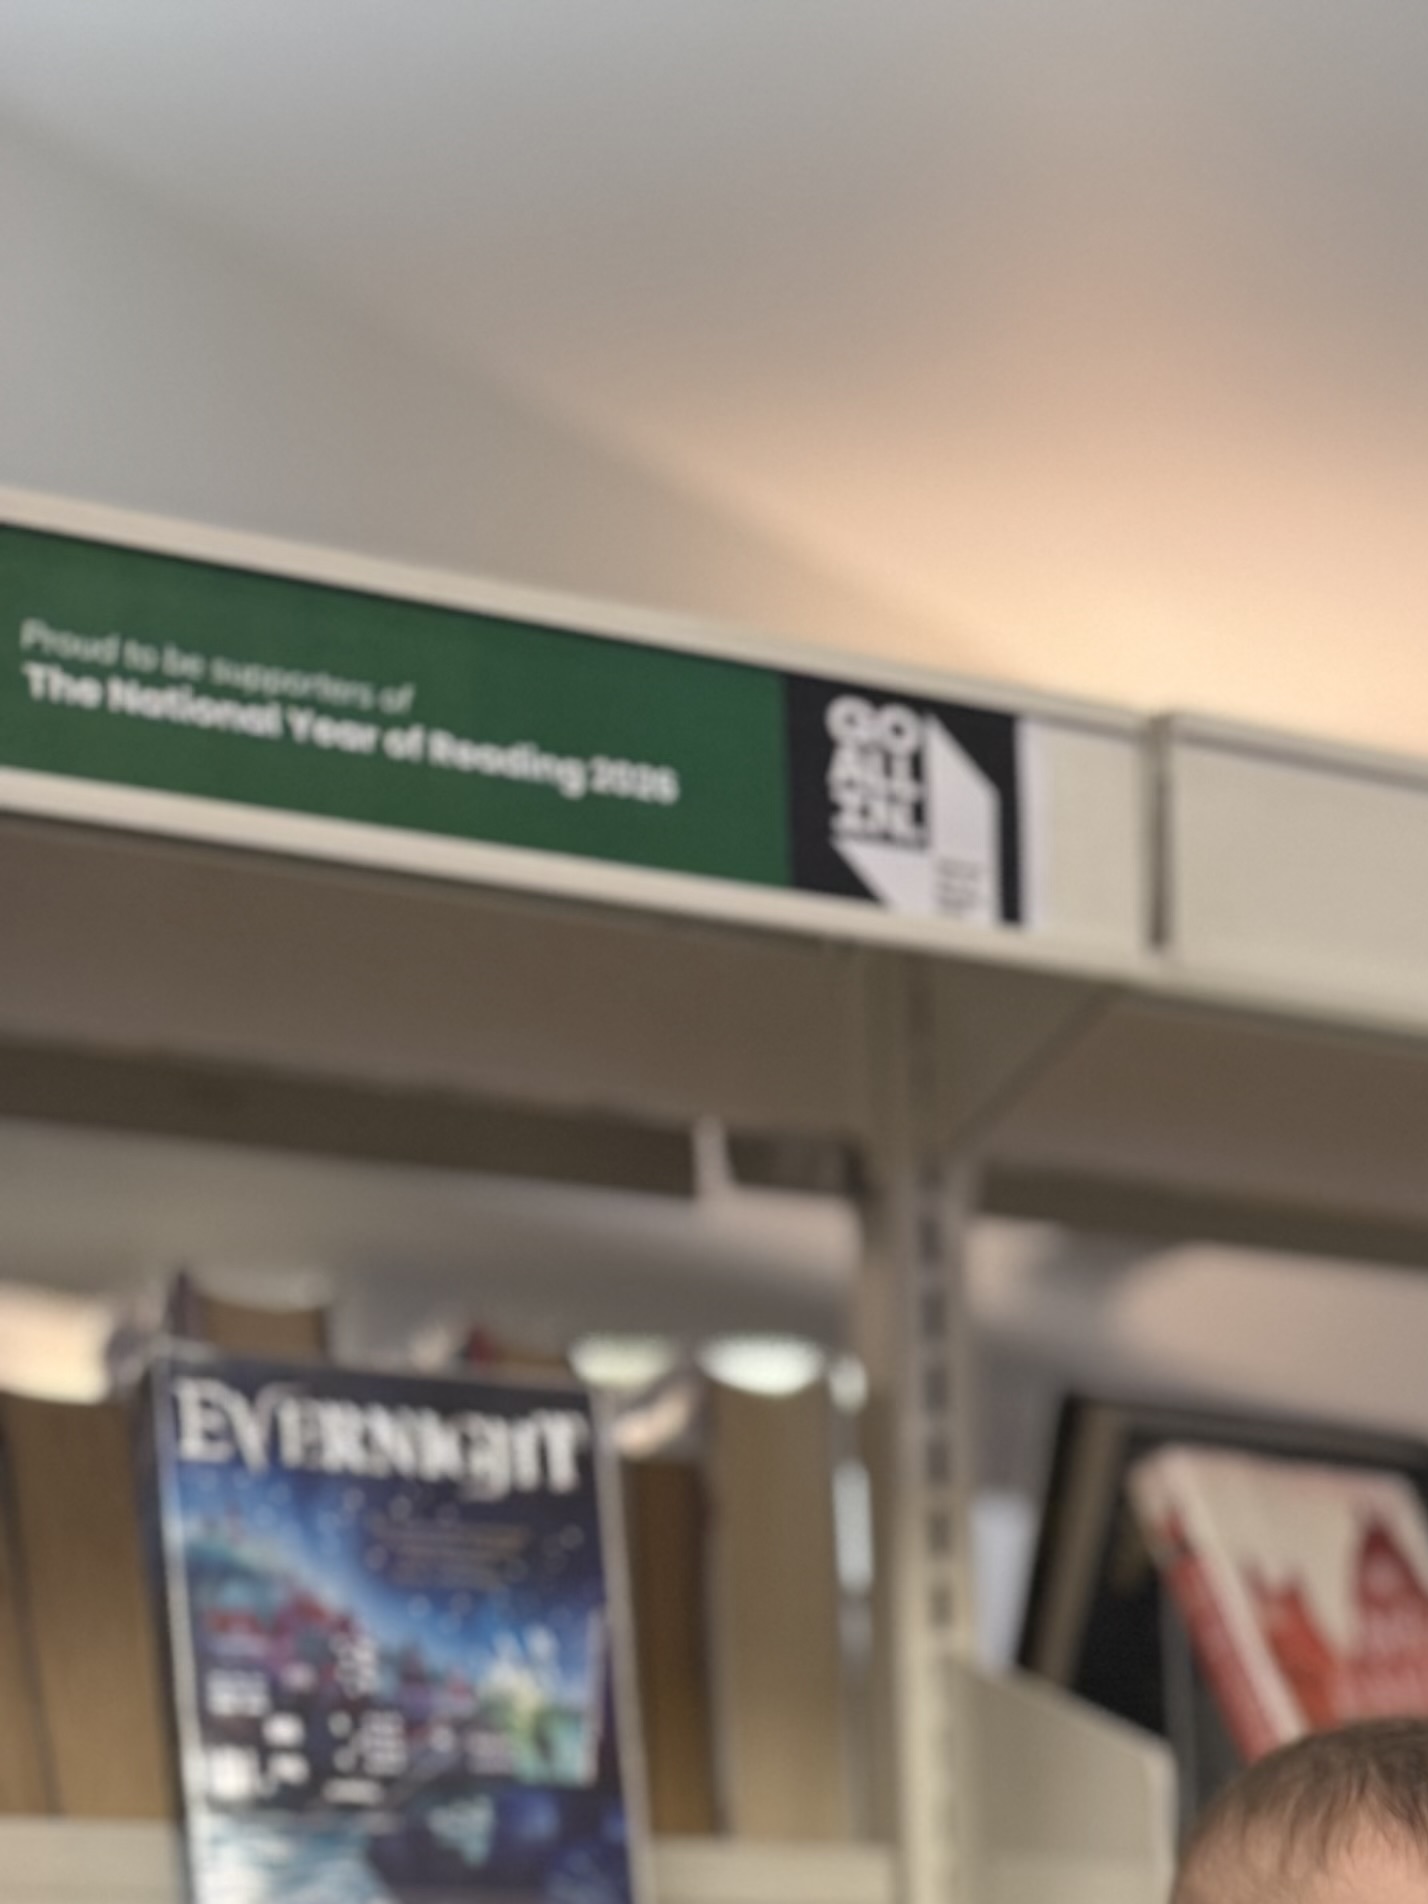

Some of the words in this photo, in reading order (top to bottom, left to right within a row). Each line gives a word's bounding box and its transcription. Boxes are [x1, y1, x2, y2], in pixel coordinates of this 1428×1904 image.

[20, 617, 121, 667] Proud
[123, 638, 160, 673] to
[161, 640, 205, 680] be
[208, 654, 375, 711] supporters
[377, 681, 416, 714] of
[21, 660, 102, 709] The
[105, 674, 284, 740] National
[284, 702, 380, 754] Year
[381, 721, 426, 764] of
[426, 726, 588, 801] Reading
[172, 1378, 590, 1502] EVERNIGHT
